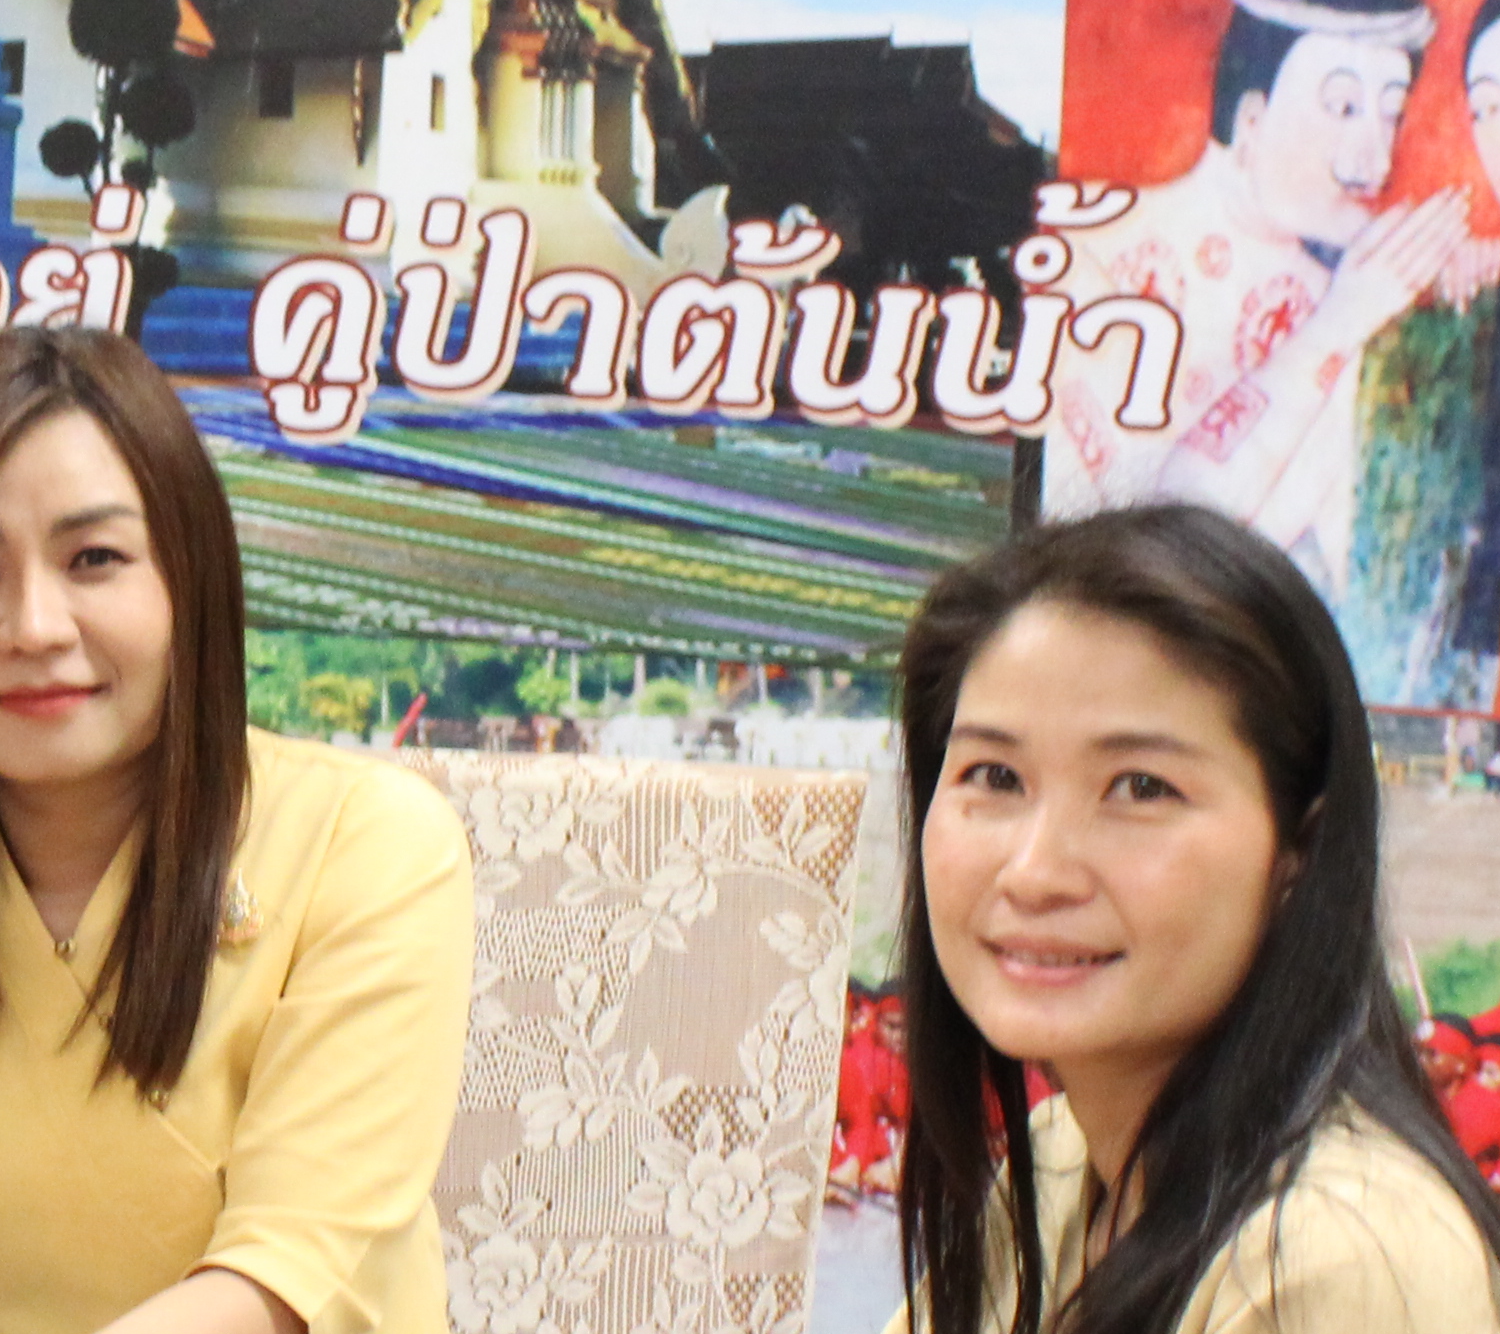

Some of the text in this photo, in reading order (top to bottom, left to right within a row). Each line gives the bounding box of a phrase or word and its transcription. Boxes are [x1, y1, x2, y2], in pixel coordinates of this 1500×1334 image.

[247, 178, 1186, 443] คู่ป่าต้นน้ำ
